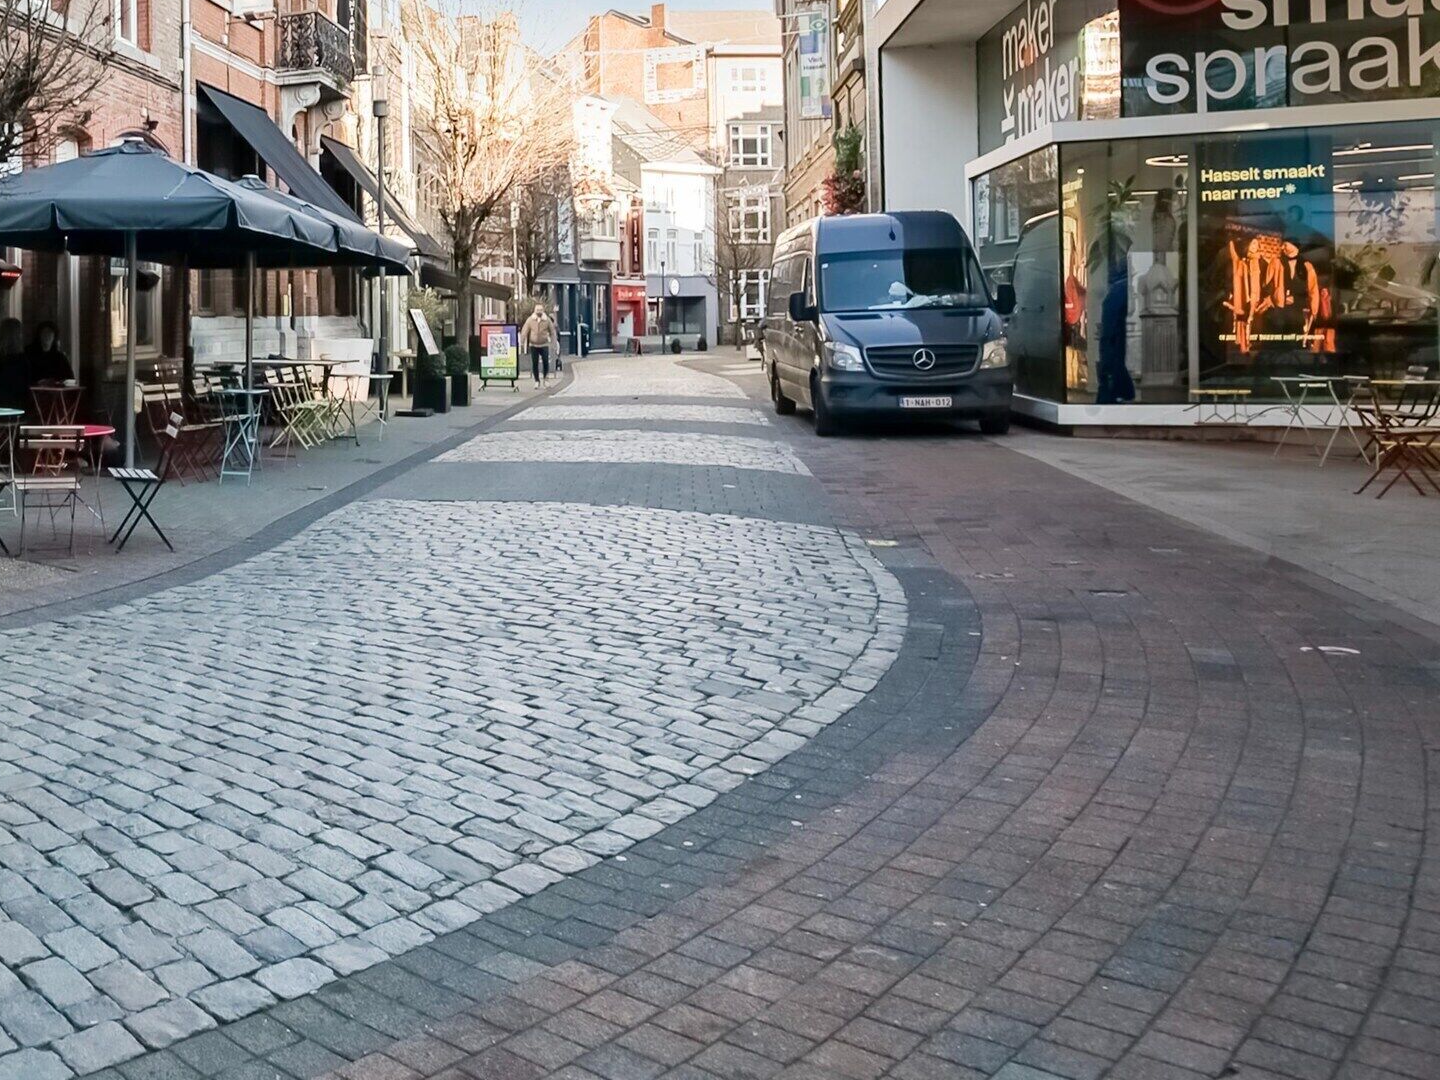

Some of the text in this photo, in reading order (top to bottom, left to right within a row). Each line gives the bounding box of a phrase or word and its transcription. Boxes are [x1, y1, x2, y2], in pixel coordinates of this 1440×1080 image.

[1018, 57, 1079, 137] maker
[1201, 164, 1325, 182] Hasselt smaakt
[1202, 189, 1238, 201] naar
[487, 367, 513, 376] OPEN
